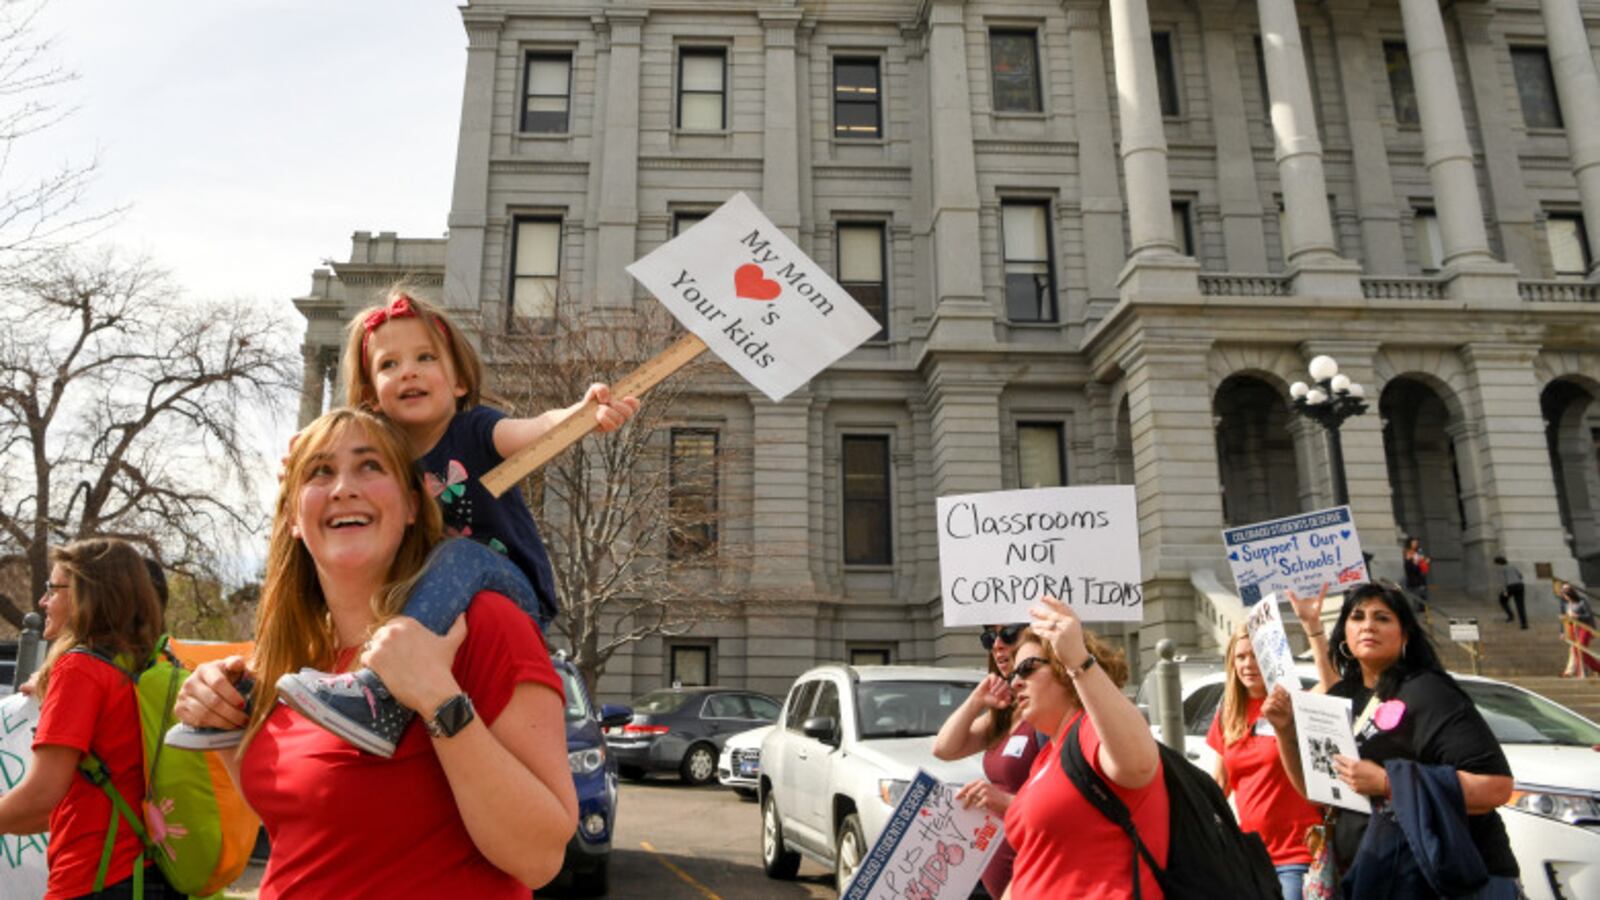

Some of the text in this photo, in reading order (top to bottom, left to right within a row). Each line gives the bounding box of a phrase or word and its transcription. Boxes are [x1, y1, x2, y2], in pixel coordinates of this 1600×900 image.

[740, 228, 835, 316] My Mom
[671, 269, 775, 369] Your kids
[946, 502, 1110, 539] Classrooms
[1005, 537, 1066, 565] NOT
[1241, 532, 1338, 566] Support Our
[1279, 545, 1342, 576] Schools!
[951, 573, 1143, 606] CORPORATIONS
[898, 846, 923, 873] US
[918, 786, 955, 842] HELP
